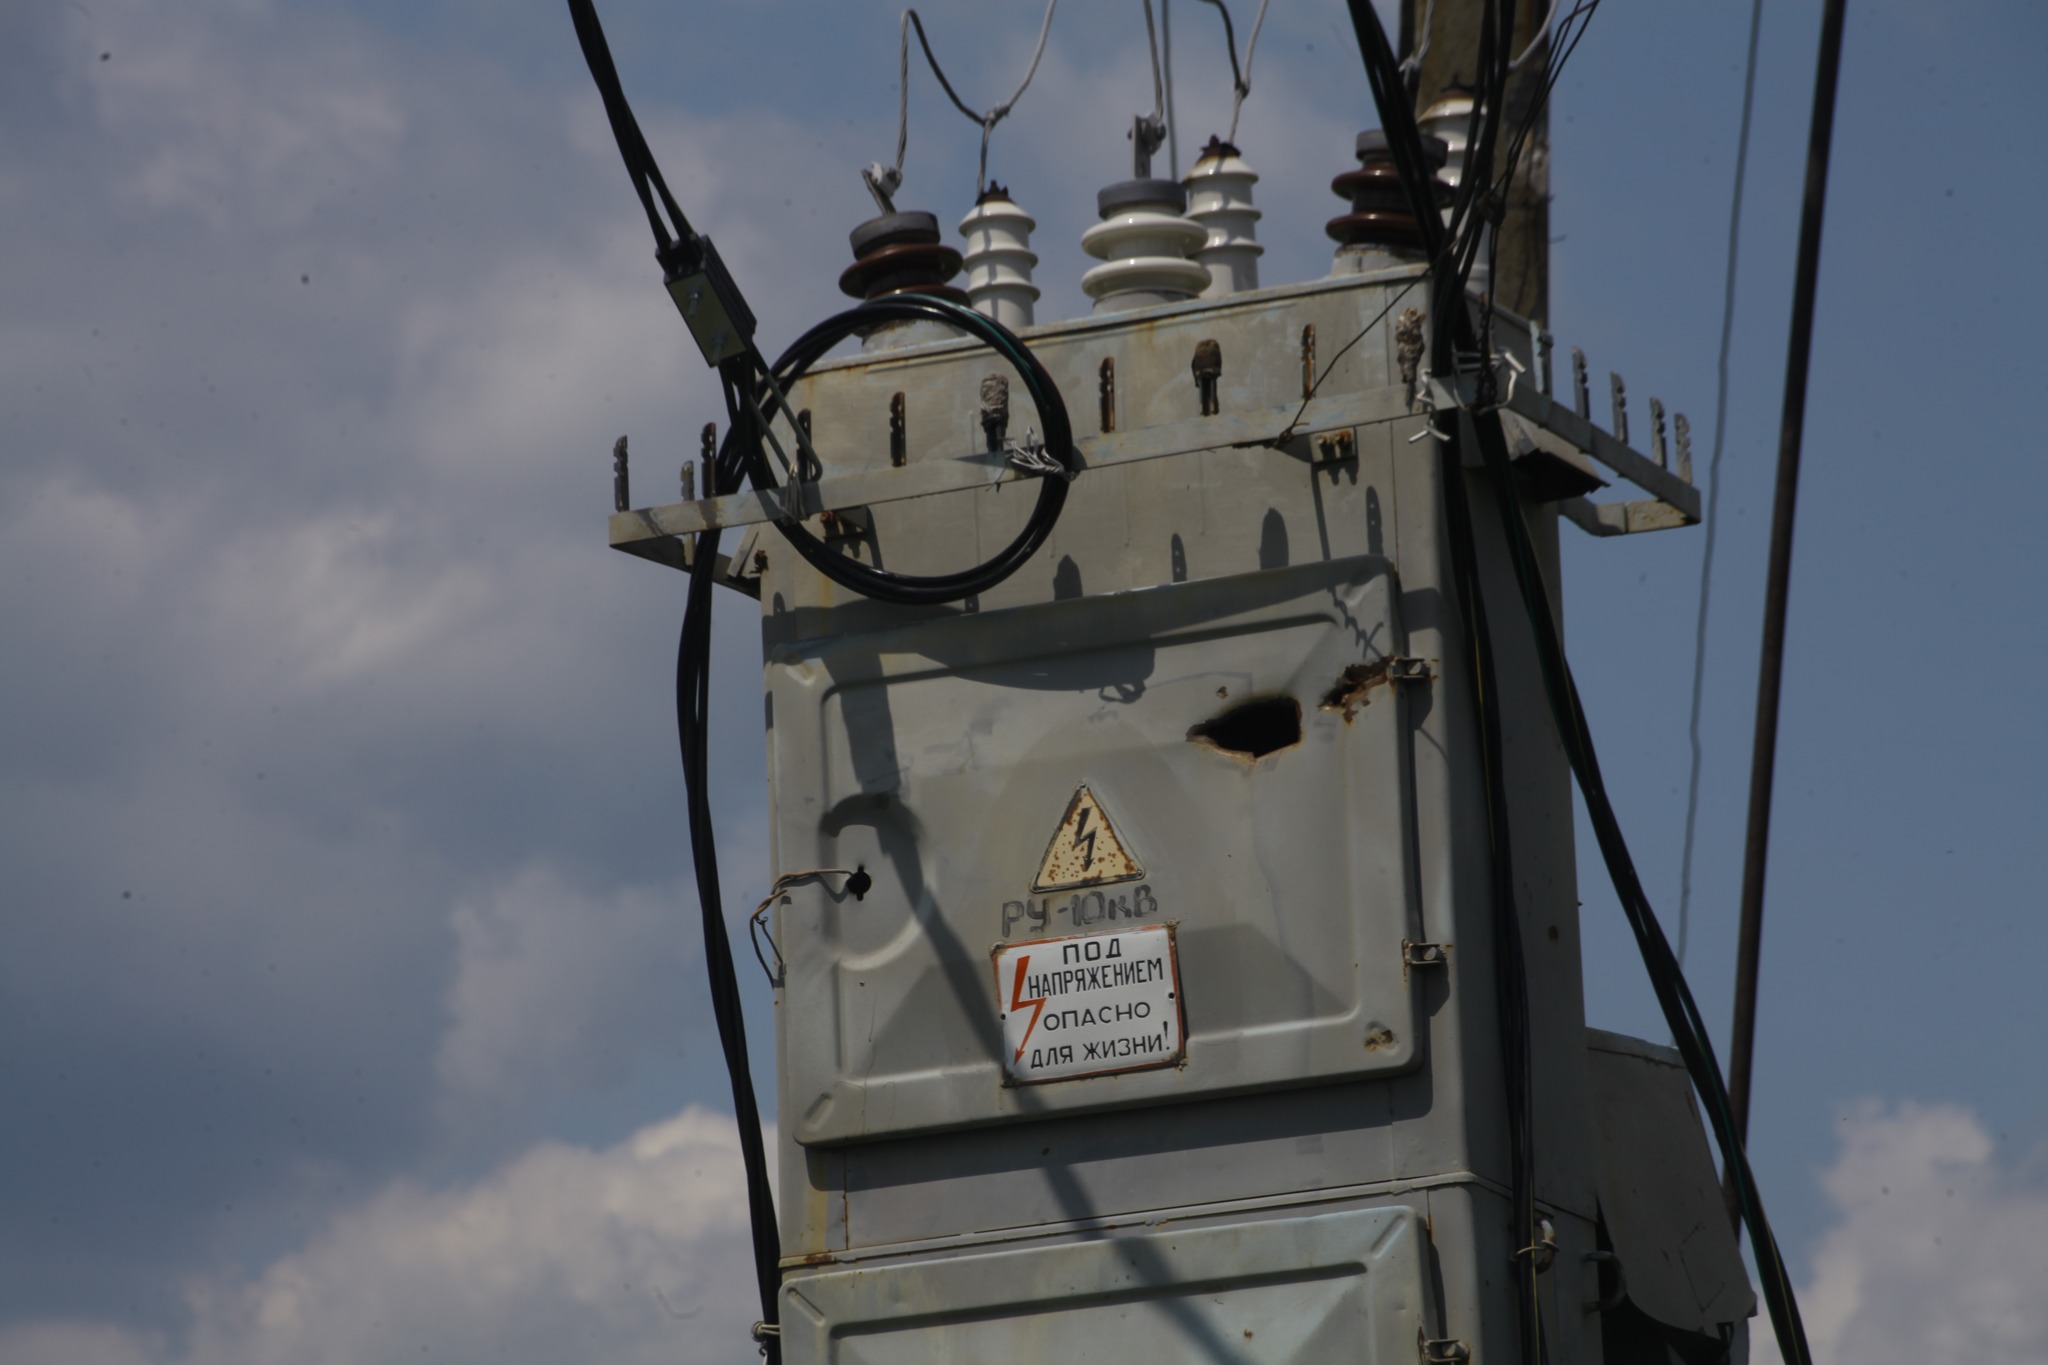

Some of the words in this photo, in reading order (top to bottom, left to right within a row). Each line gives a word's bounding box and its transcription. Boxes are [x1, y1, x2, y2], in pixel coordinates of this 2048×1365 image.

[1063, 938, 1122, 965] ПОД
[1028, 958, 1163, 999] НАПРЯЖЕНИЕМ
[1043, 1002, 1151, 1031] ОПАСНО
[1030, 1045, 1073, 1070] ДЛЯ
[1083, 1021, 1170, 1061] ЖИЗНИ!
